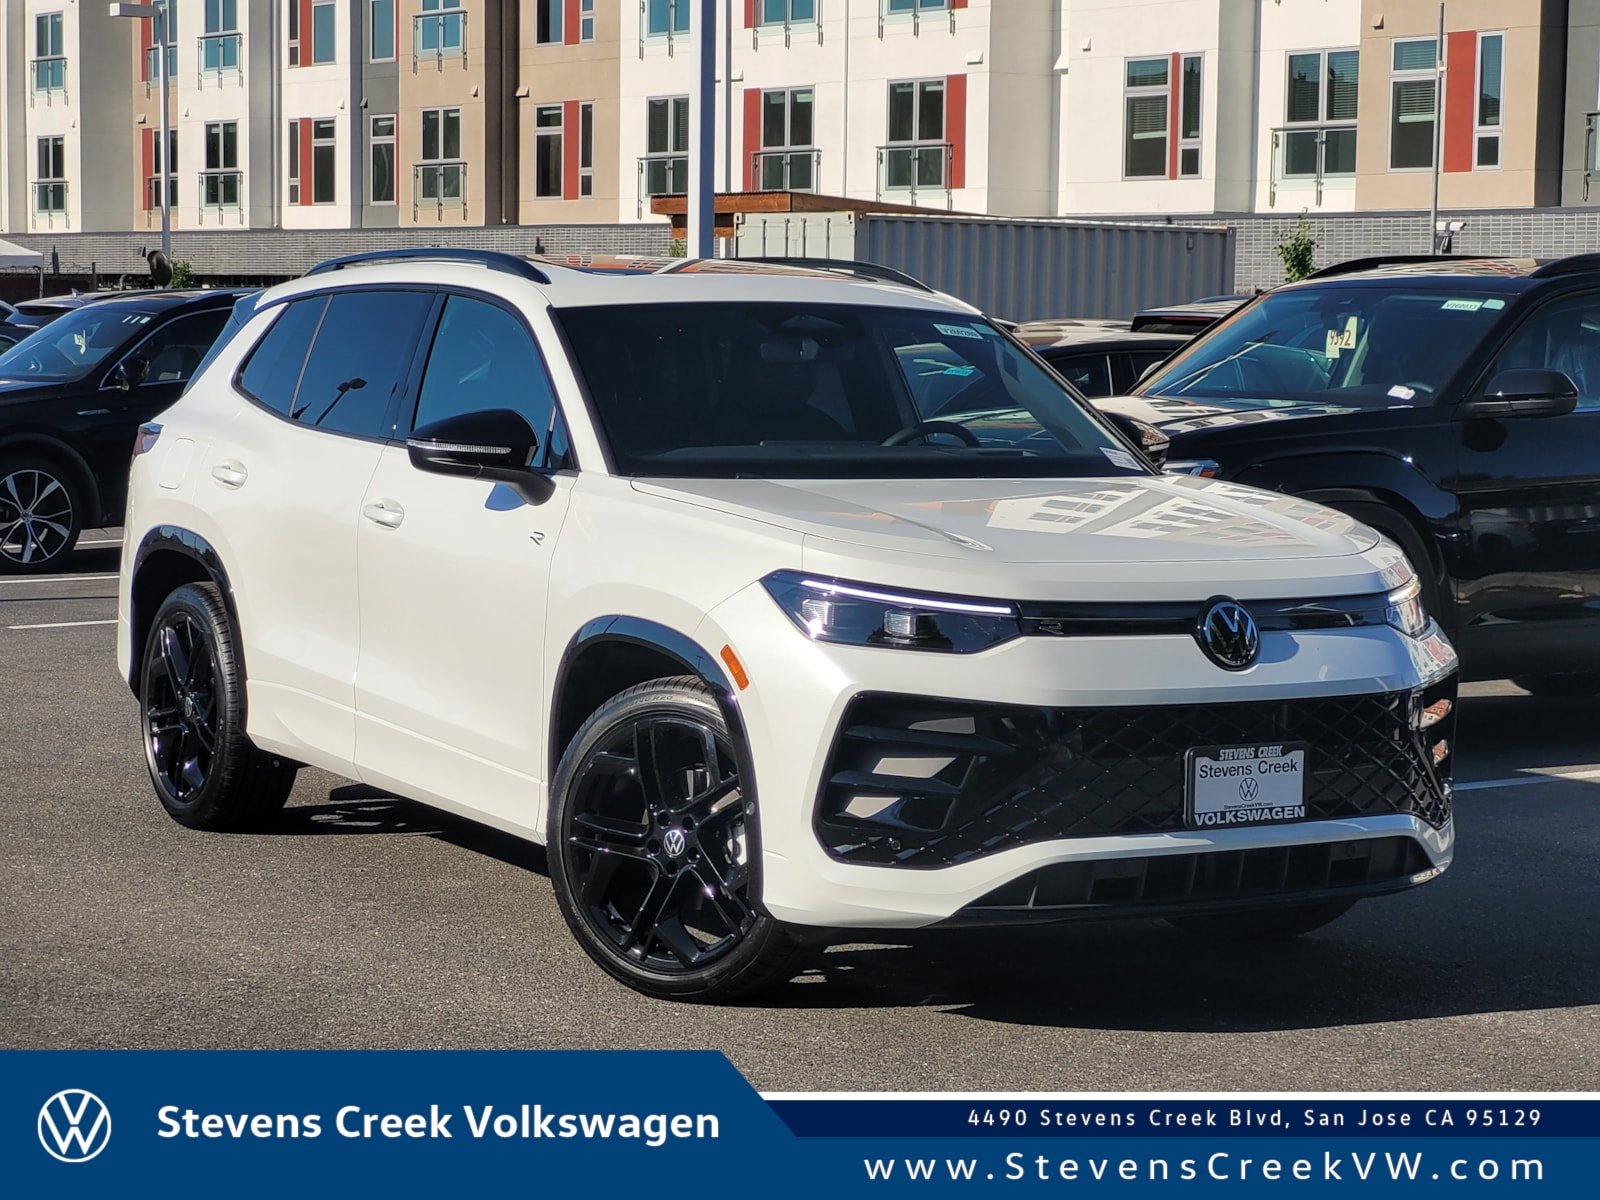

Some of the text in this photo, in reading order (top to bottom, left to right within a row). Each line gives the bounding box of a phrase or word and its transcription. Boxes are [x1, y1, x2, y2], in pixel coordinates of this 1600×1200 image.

[1219, 746, 1283, 760] STEVENS CREEK
[1199, 759, 1299, 779] Stevens Creek
[1195, 806, 1305, 825] VOLKSWAGEN
